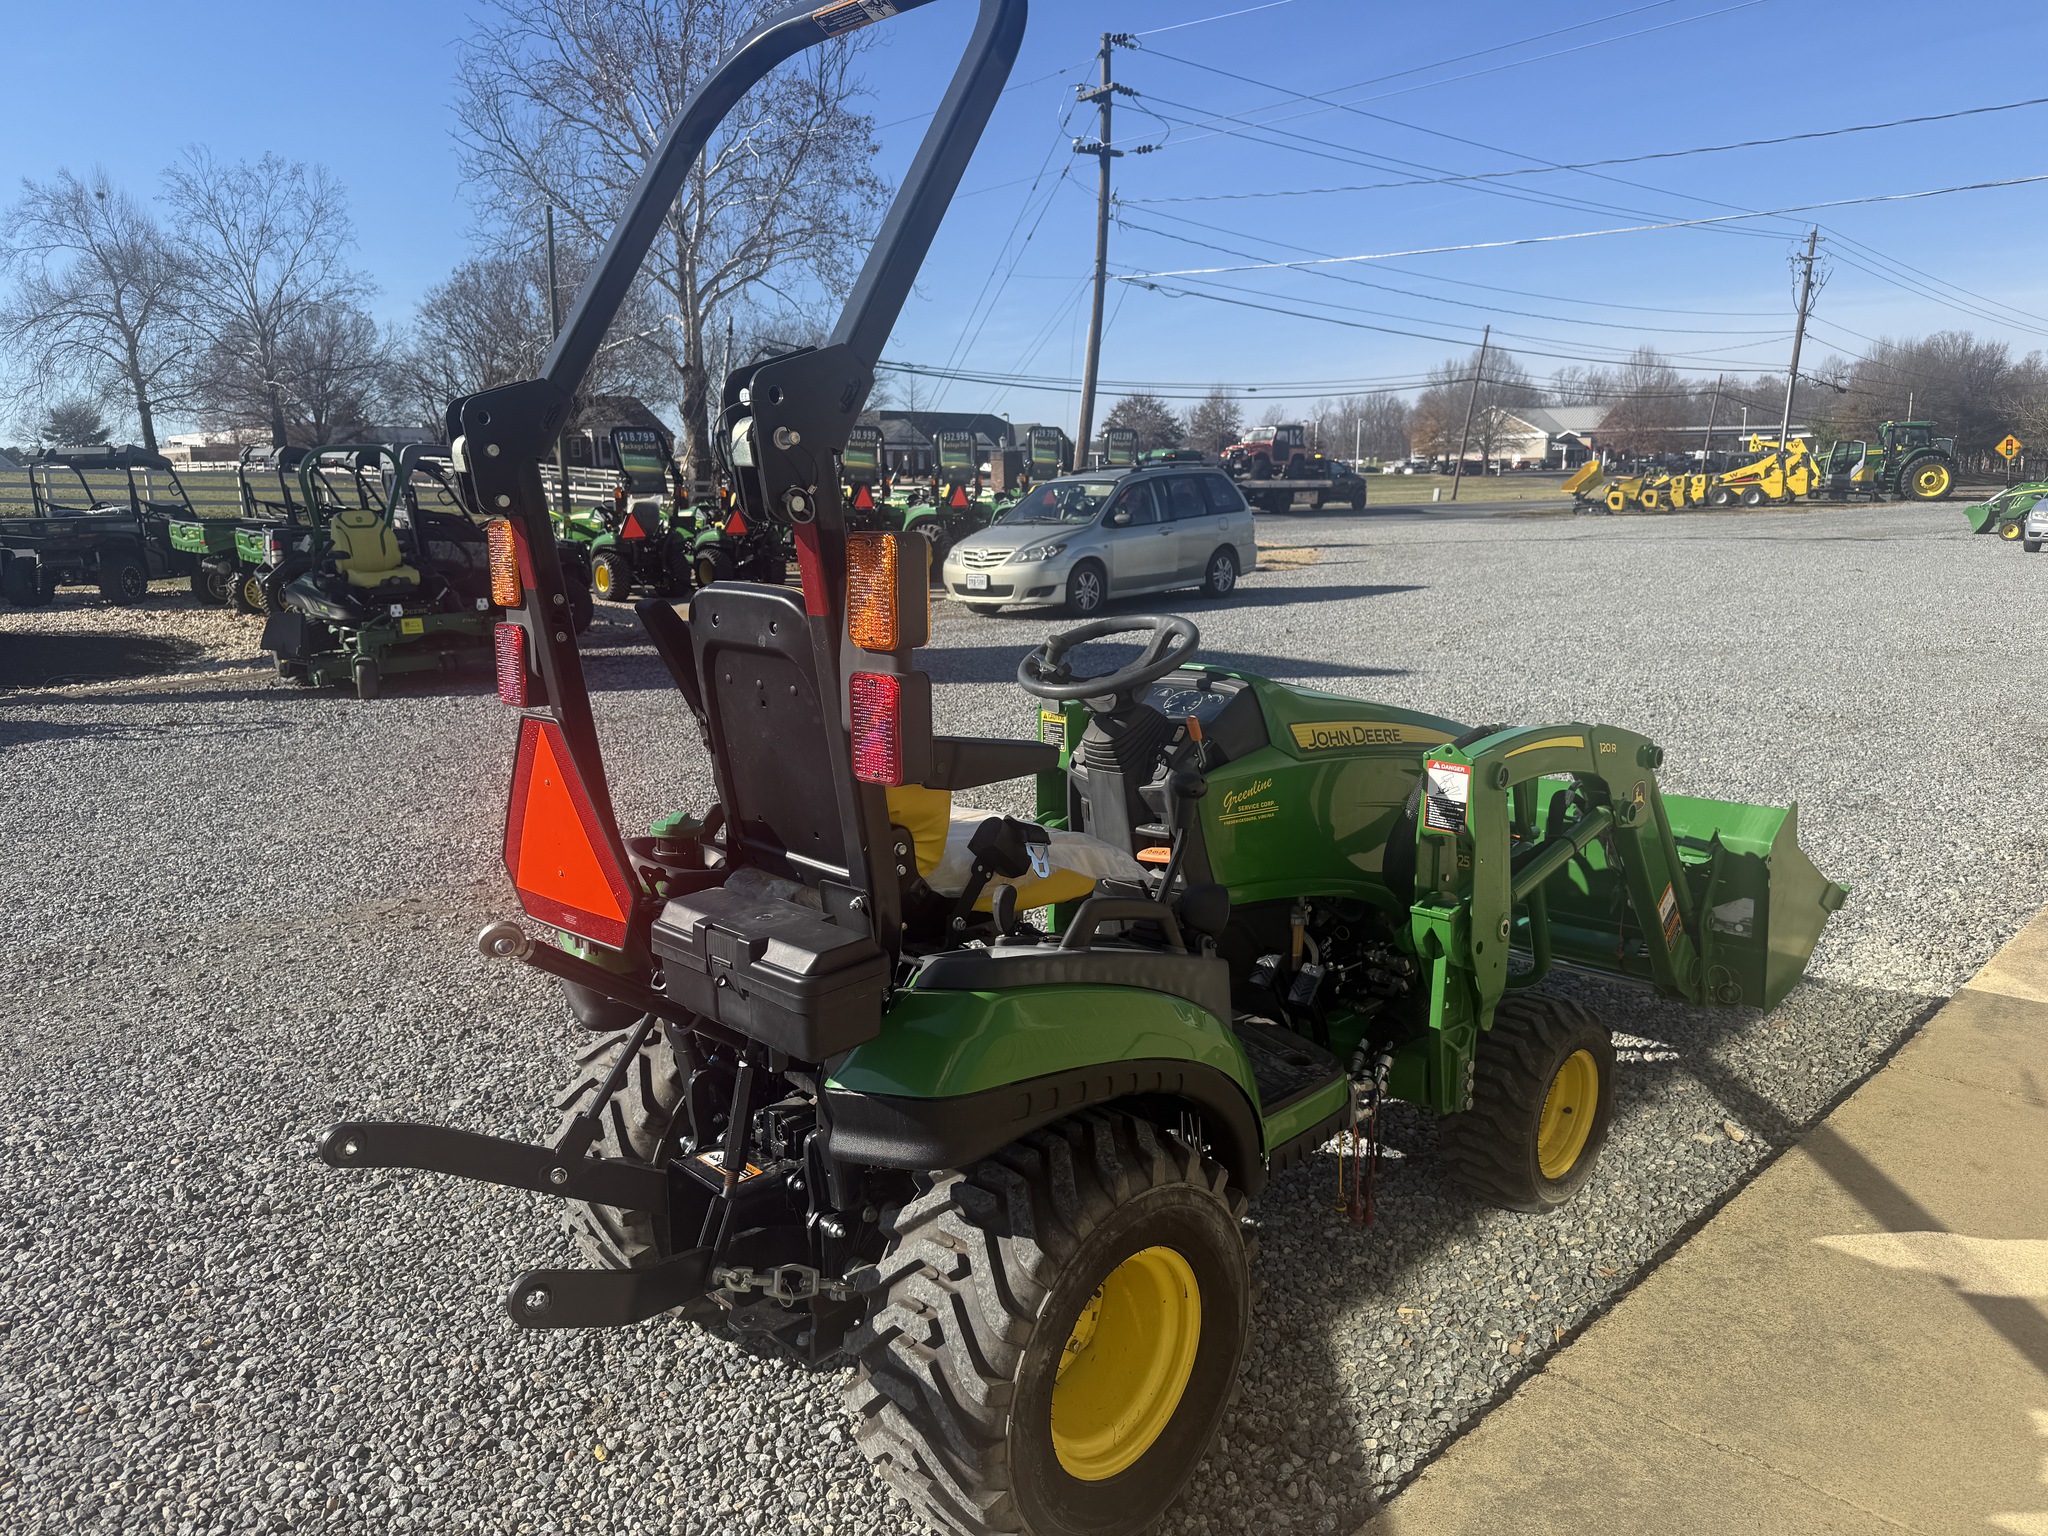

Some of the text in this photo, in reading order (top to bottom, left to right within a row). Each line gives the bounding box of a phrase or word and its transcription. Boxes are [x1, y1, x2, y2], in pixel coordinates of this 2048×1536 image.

[620, 442, 644, 451] Package
[1308, 726, 1402, 747] JOHN DEERE
[1441, 763, 1465, 772] DANGER
[1223, 777, 1273, 813] Greenline
[1237, 800, 1276, 812] SERVICE CORP.
